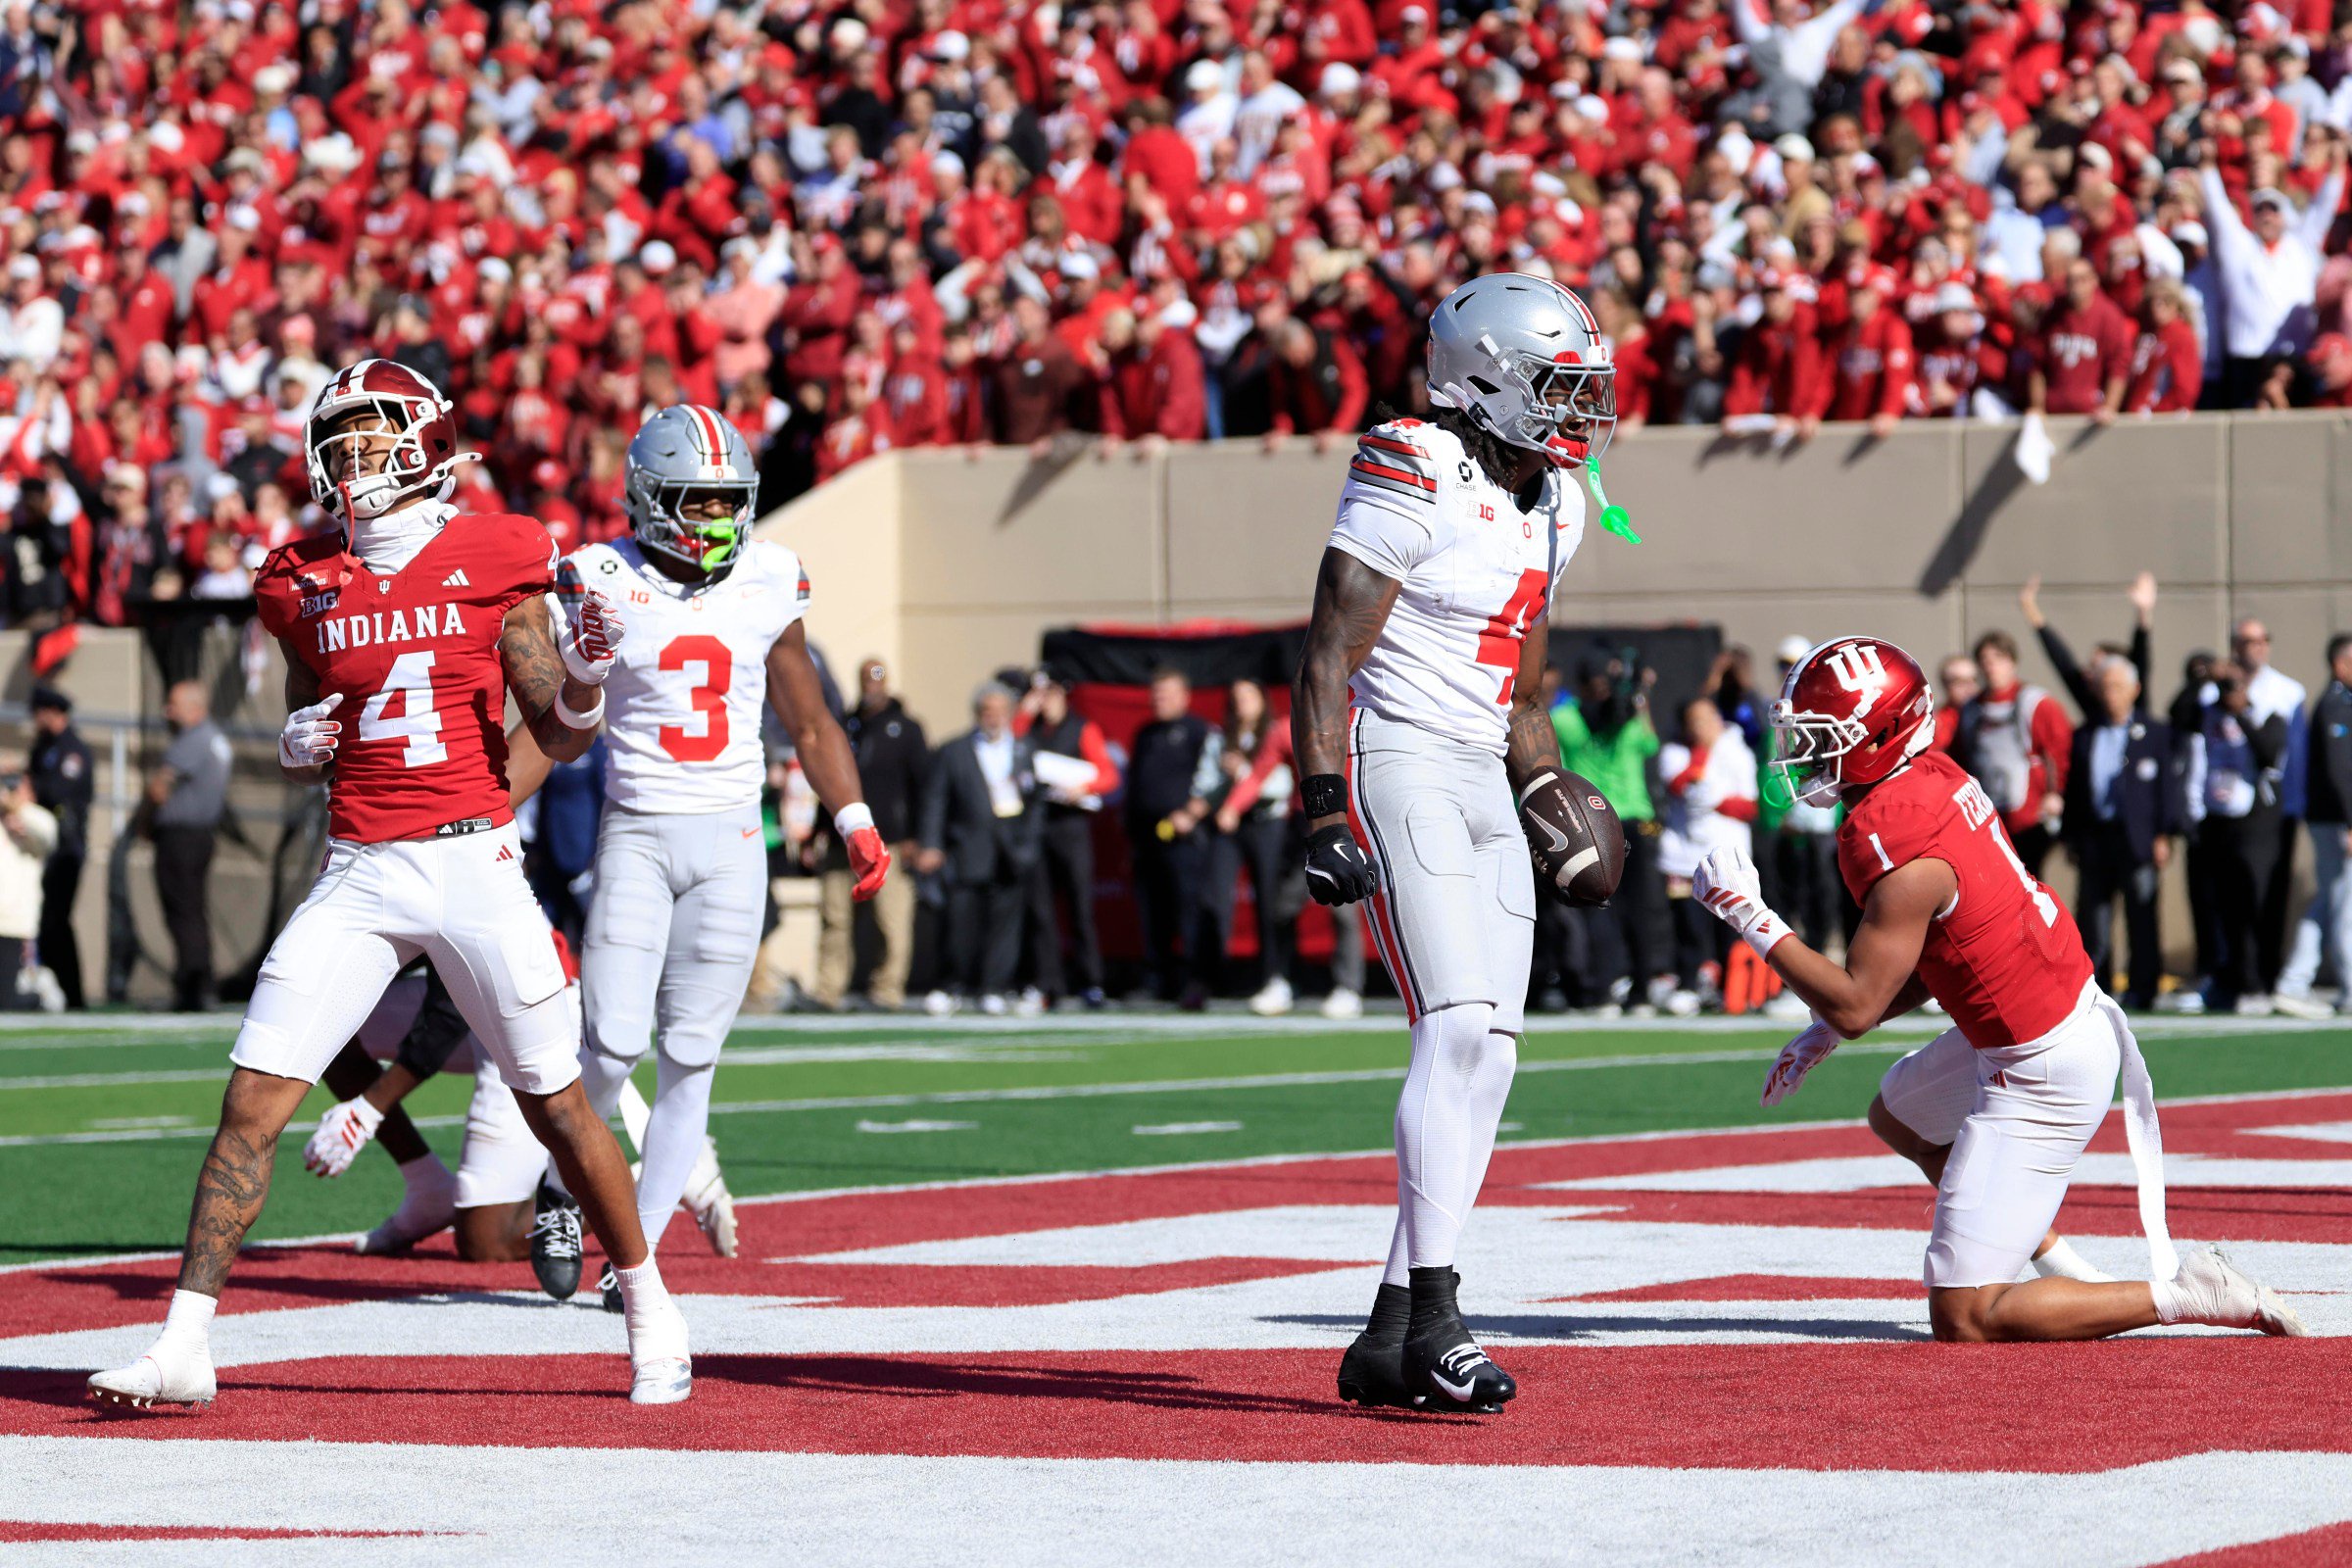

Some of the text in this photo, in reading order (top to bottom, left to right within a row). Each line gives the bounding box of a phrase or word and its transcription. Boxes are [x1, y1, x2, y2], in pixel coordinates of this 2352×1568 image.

[1455, 482, 1477, 492] CHASE
[316, 603, 466, 655] INDIANA
[1474, 567, 1548, 707] 4
[358, 650, 449, 768] 4
[658, 635, 733, 762] 3
[1868, 832, 1895, 871] 1
[1988, 816, 2059, 929] 1
